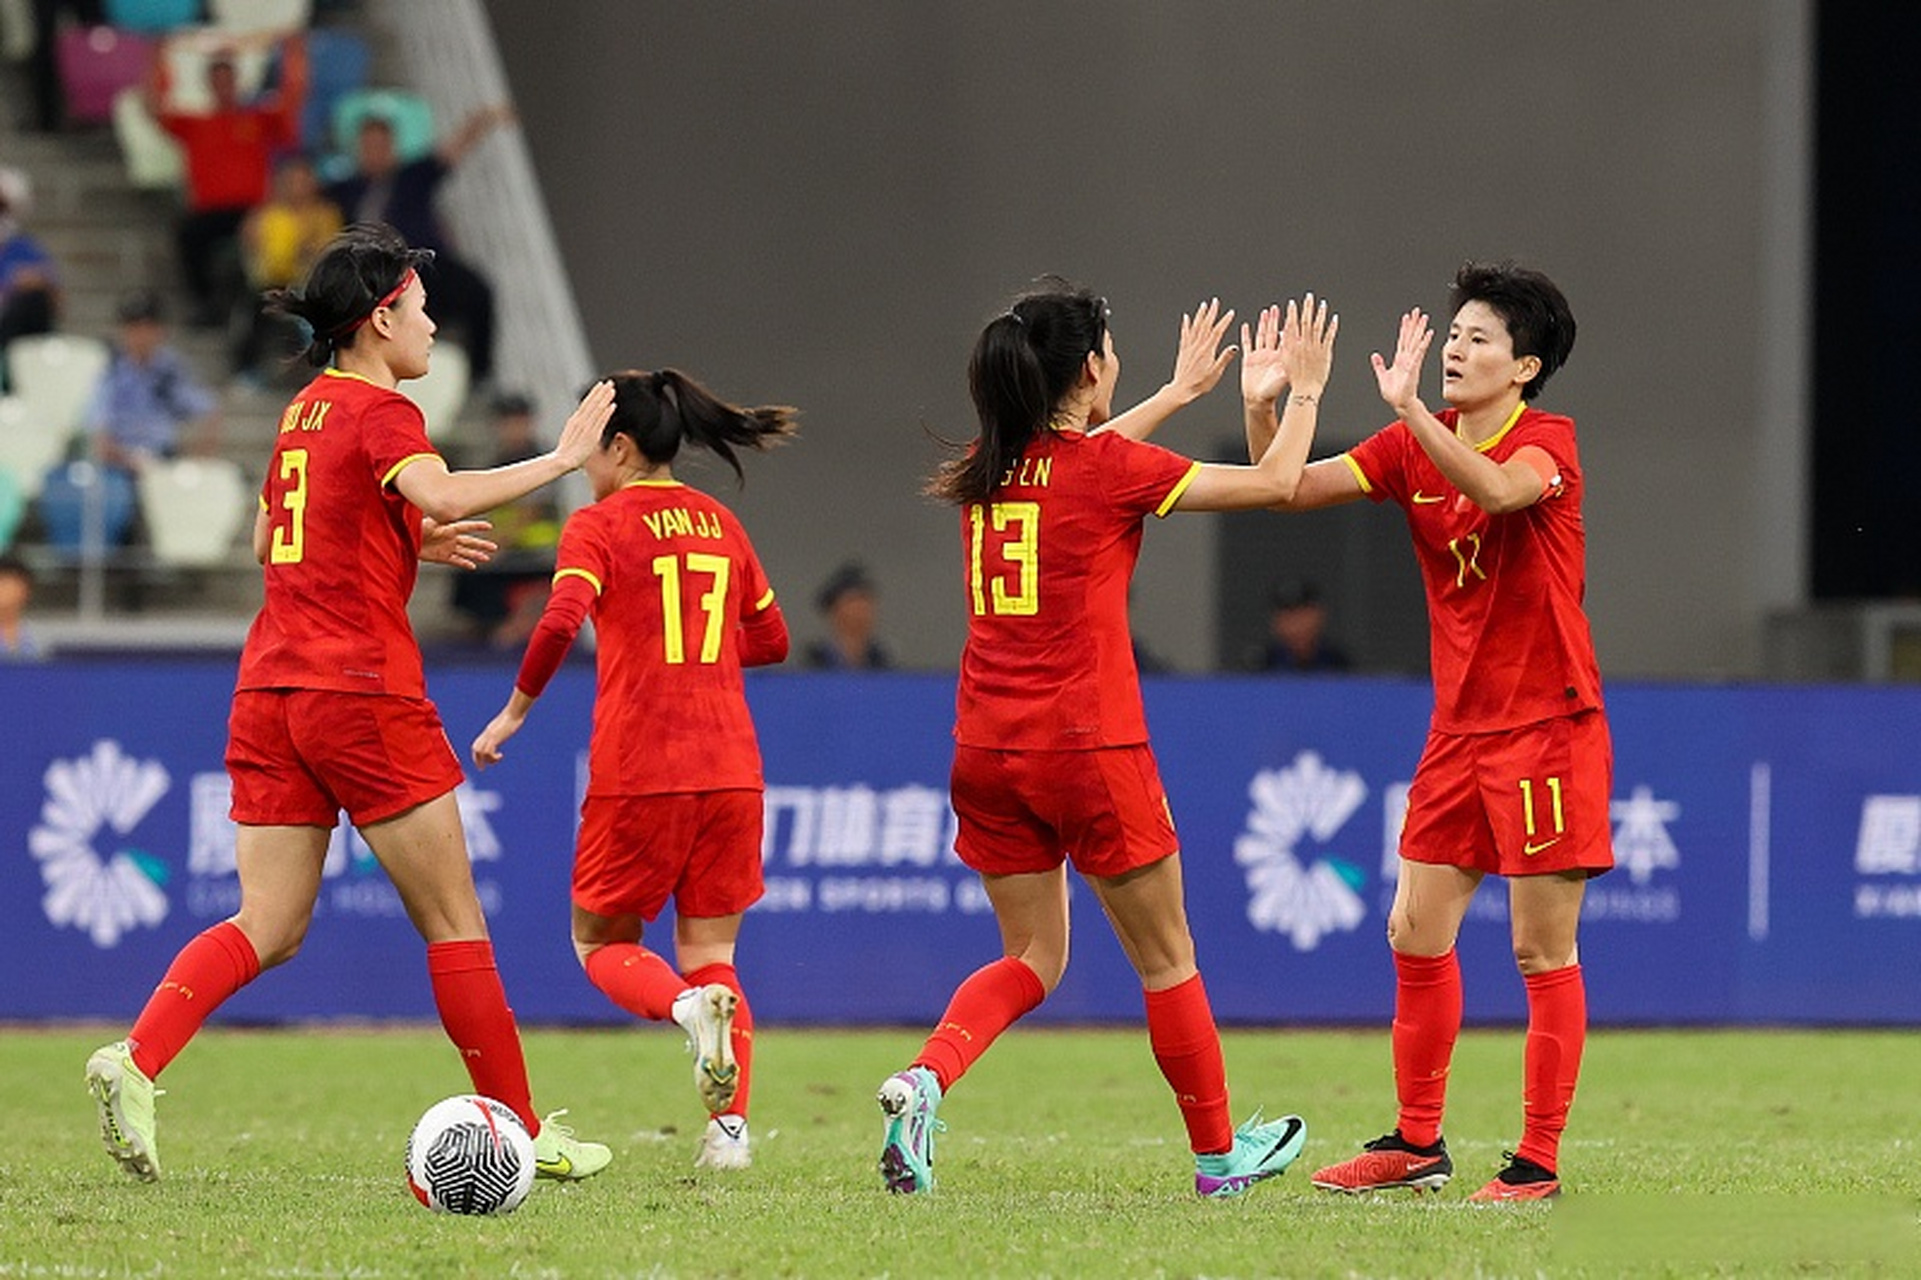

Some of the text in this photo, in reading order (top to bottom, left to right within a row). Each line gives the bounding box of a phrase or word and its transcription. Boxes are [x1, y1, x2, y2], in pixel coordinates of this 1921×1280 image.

[301, 401, 332, 431] JX
[271, 449, 307, 564] 3
[696, 511, 722, 539] JJ
[970, 502, 1040, 616] 13
[652, 552, 731, 664] 17
[1519, 777, 1564, 836] 11
